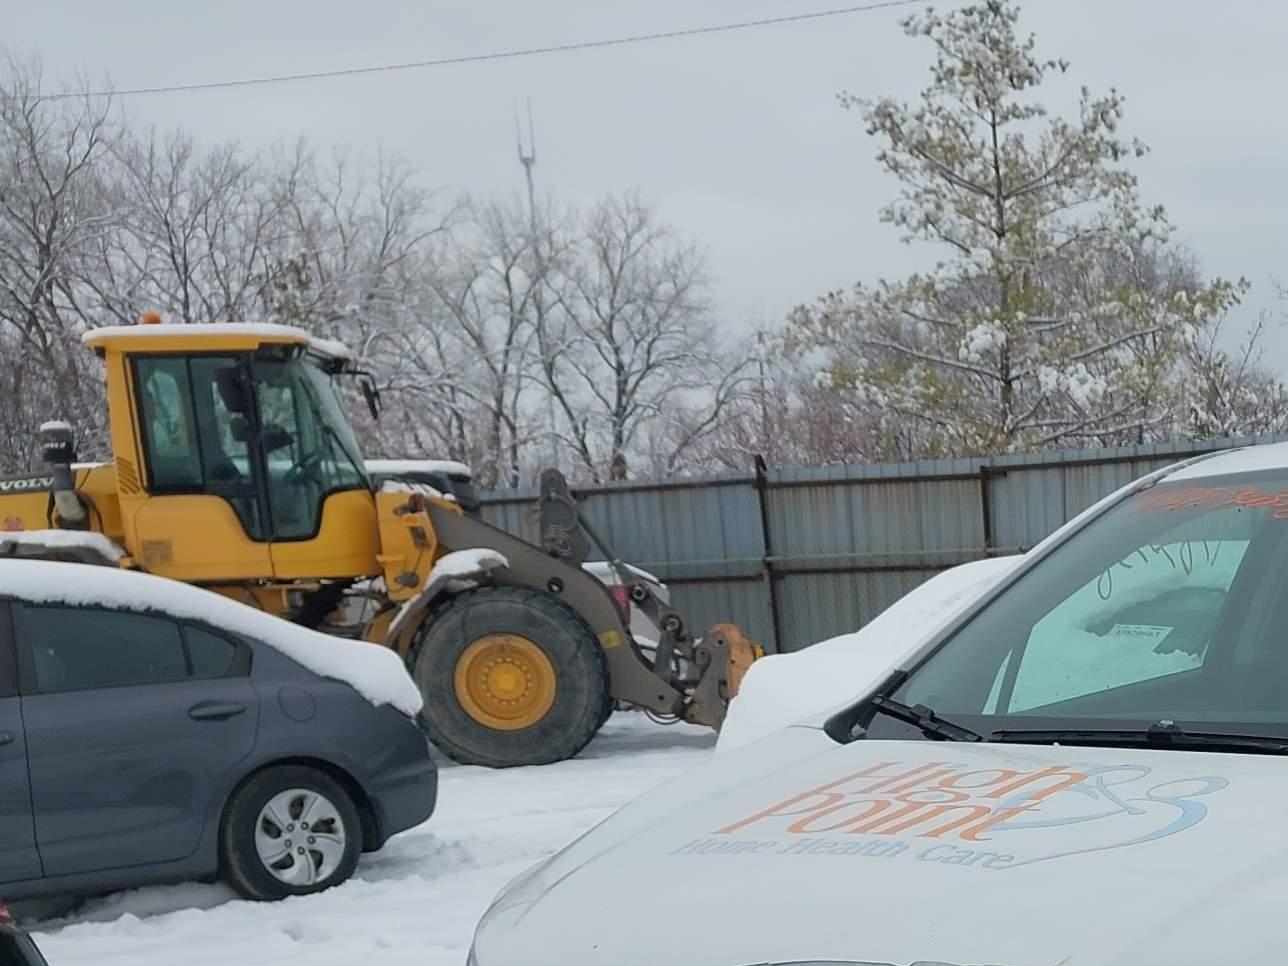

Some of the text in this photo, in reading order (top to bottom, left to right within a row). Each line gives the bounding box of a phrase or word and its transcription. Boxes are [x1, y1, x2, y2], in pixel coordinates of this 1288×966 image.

[0, 477, 55, 491] VOLV
[800, 761, 1088, 804] High
[708, 792, 1041, 841] Point
[667, 838, 1015, 870] Home Health Care
